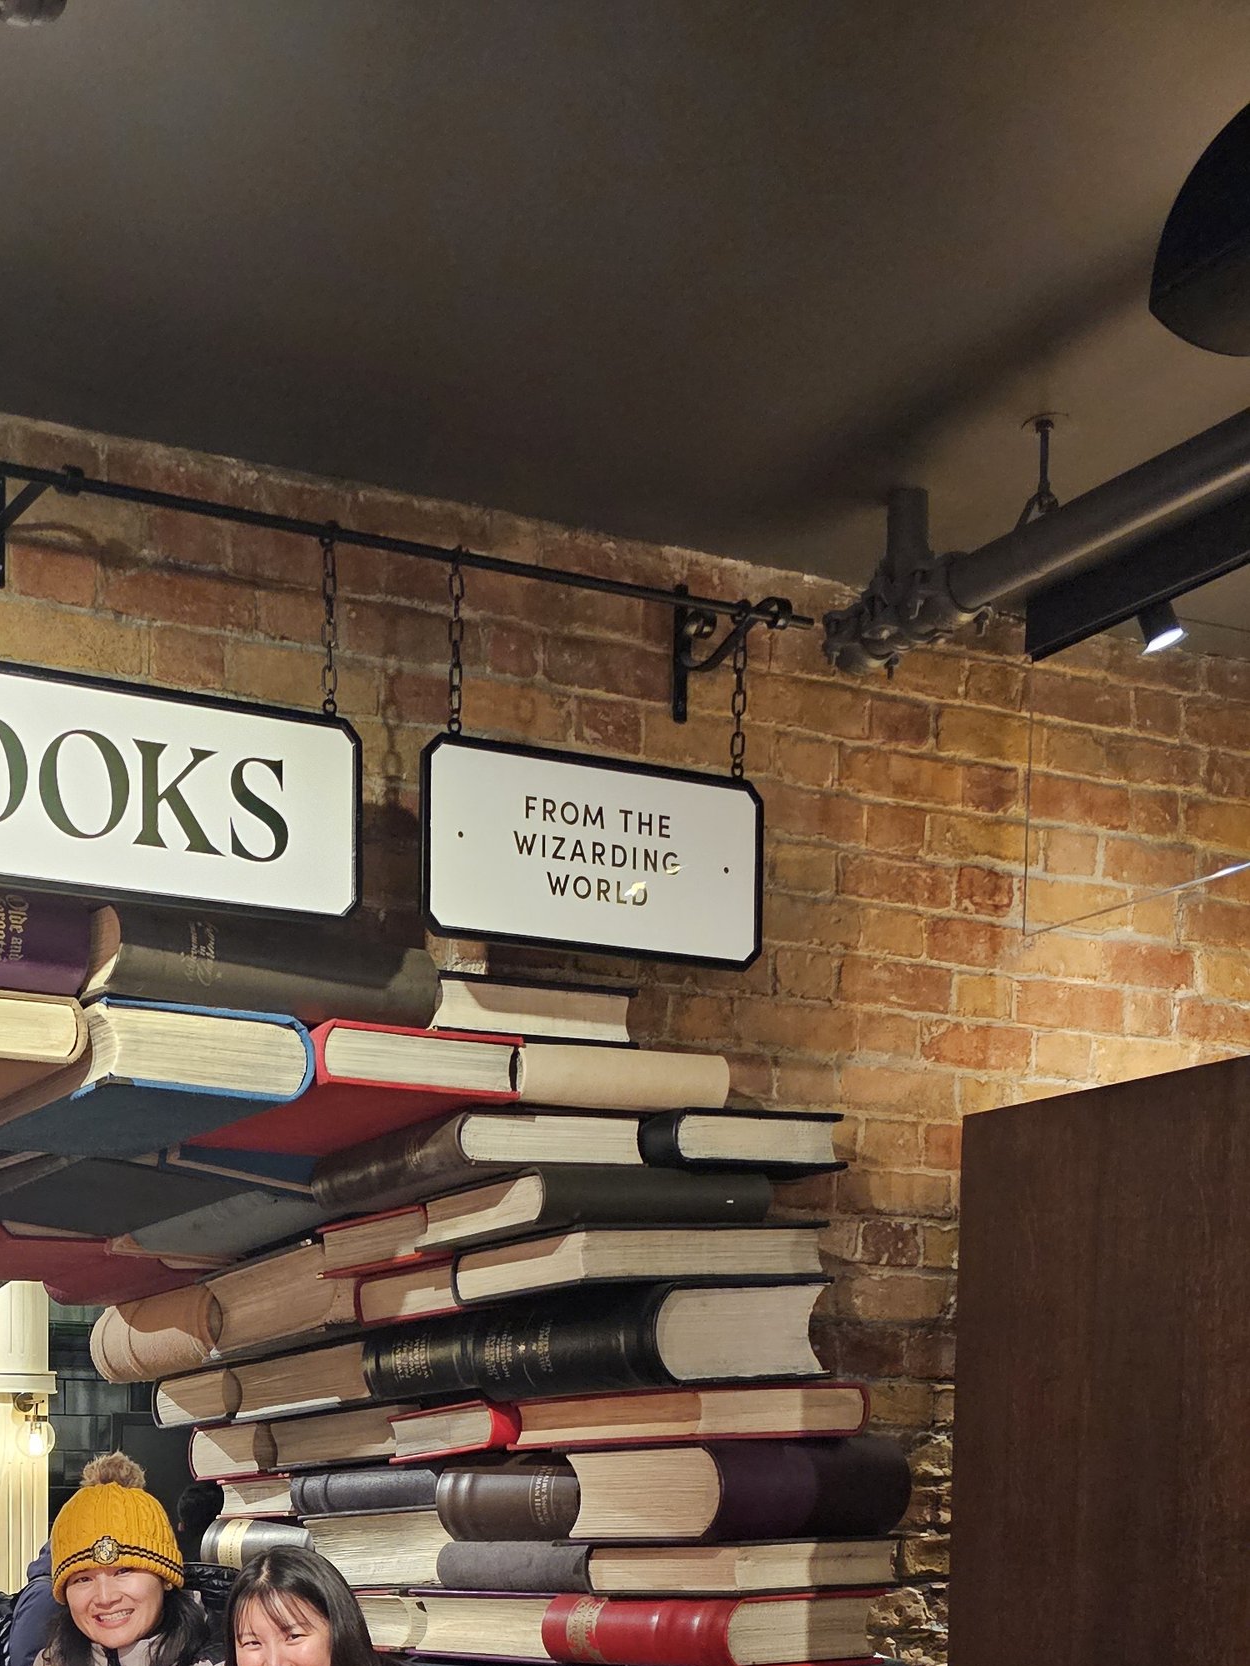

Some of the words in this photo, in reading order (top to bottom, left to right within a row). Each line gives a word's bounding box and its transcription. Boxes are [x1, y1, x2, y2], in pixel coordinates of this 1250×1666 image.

[525, 795, 605, 830] FROM
[619, 808, 672, 839] THE
[513, 830, 682, 876] WIZARDING
[546, 871, 649, 907] WORLD
[5, 894, 29, 934] Olde
[8, 936, 25, 961] and
